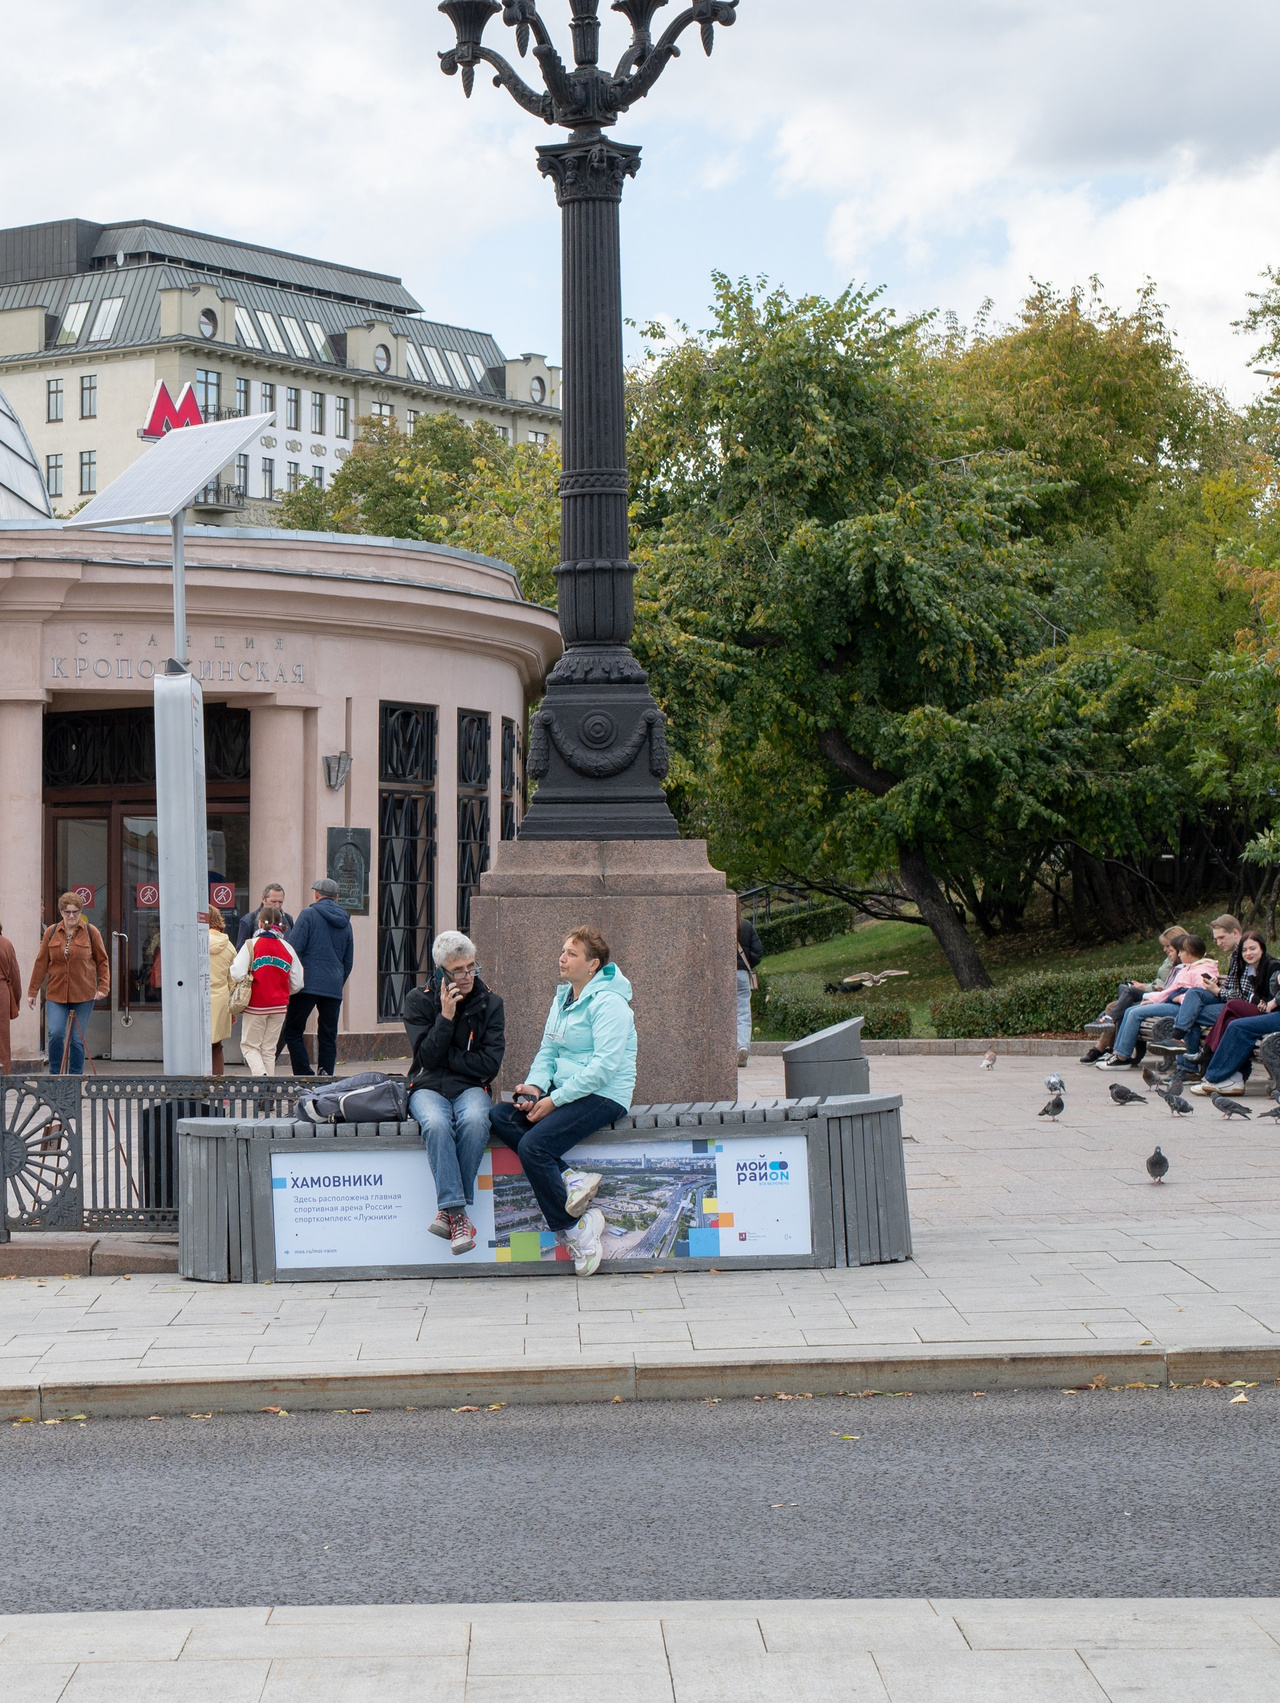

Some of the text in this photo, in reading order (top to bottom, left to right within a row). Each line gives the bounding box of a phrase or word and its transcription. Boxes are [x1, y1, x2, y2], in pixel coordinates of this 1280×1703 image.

[51, 657, 305, 684] КРОПОИНСКАЯ
[291, 1174, 383, 1189] ХАМОВНИКИ
[294, 1193, 402, 1203] Здесь расположена главная
[294, 1206, 338, 1214] спортивная
[340, 1205, 363, 1213] арена
[365, 1203, 393, 1211] России
[294, 1213, 398, 1224] спорткомплекс «Лужники»
